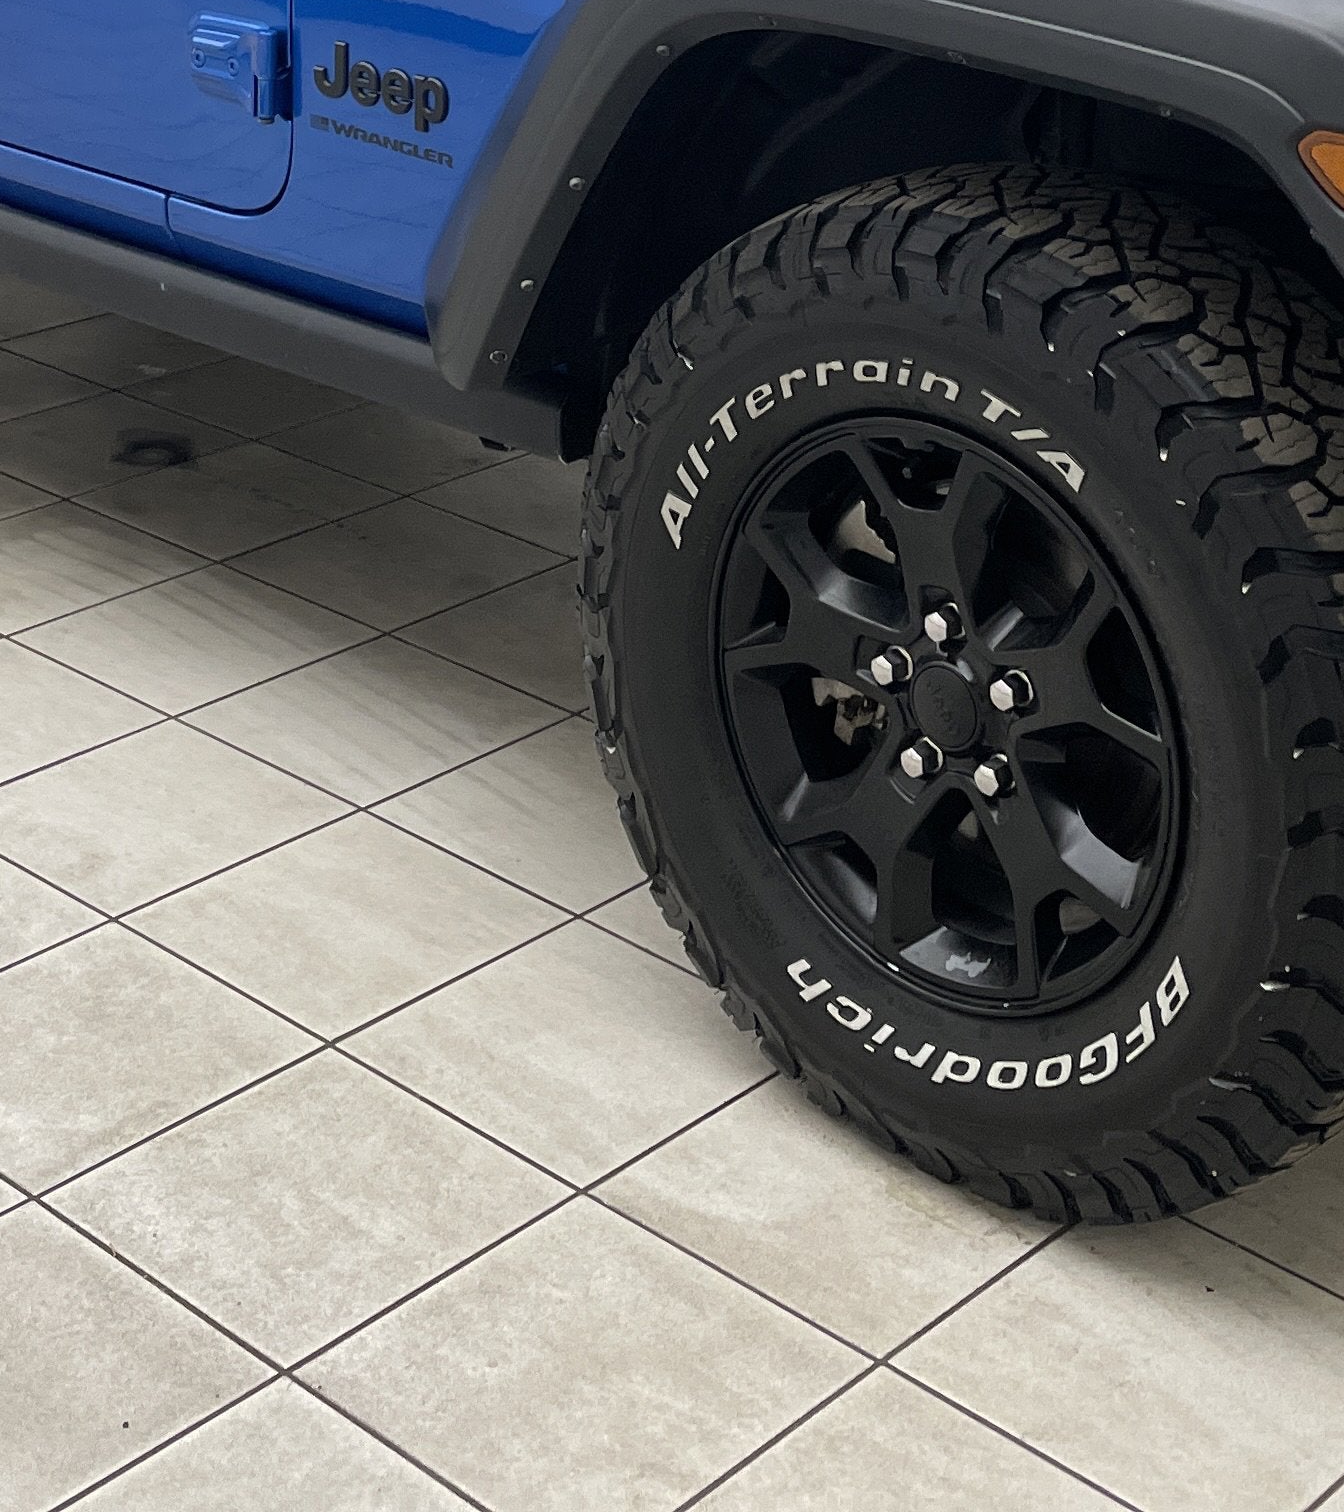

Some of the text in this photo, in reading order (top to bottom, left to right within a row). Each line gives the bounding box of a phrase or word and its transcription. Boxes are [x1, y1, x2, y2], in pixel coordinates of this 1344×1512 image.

[312, 39, 450, 134] Jeep
[329, 118, 455, 169] WRANGLER
[659, 358, 962, 550] All-Terrain
[980, 388, 1087, 494] T/A
[786, 956, 1192, 1091] BFGoodrich
